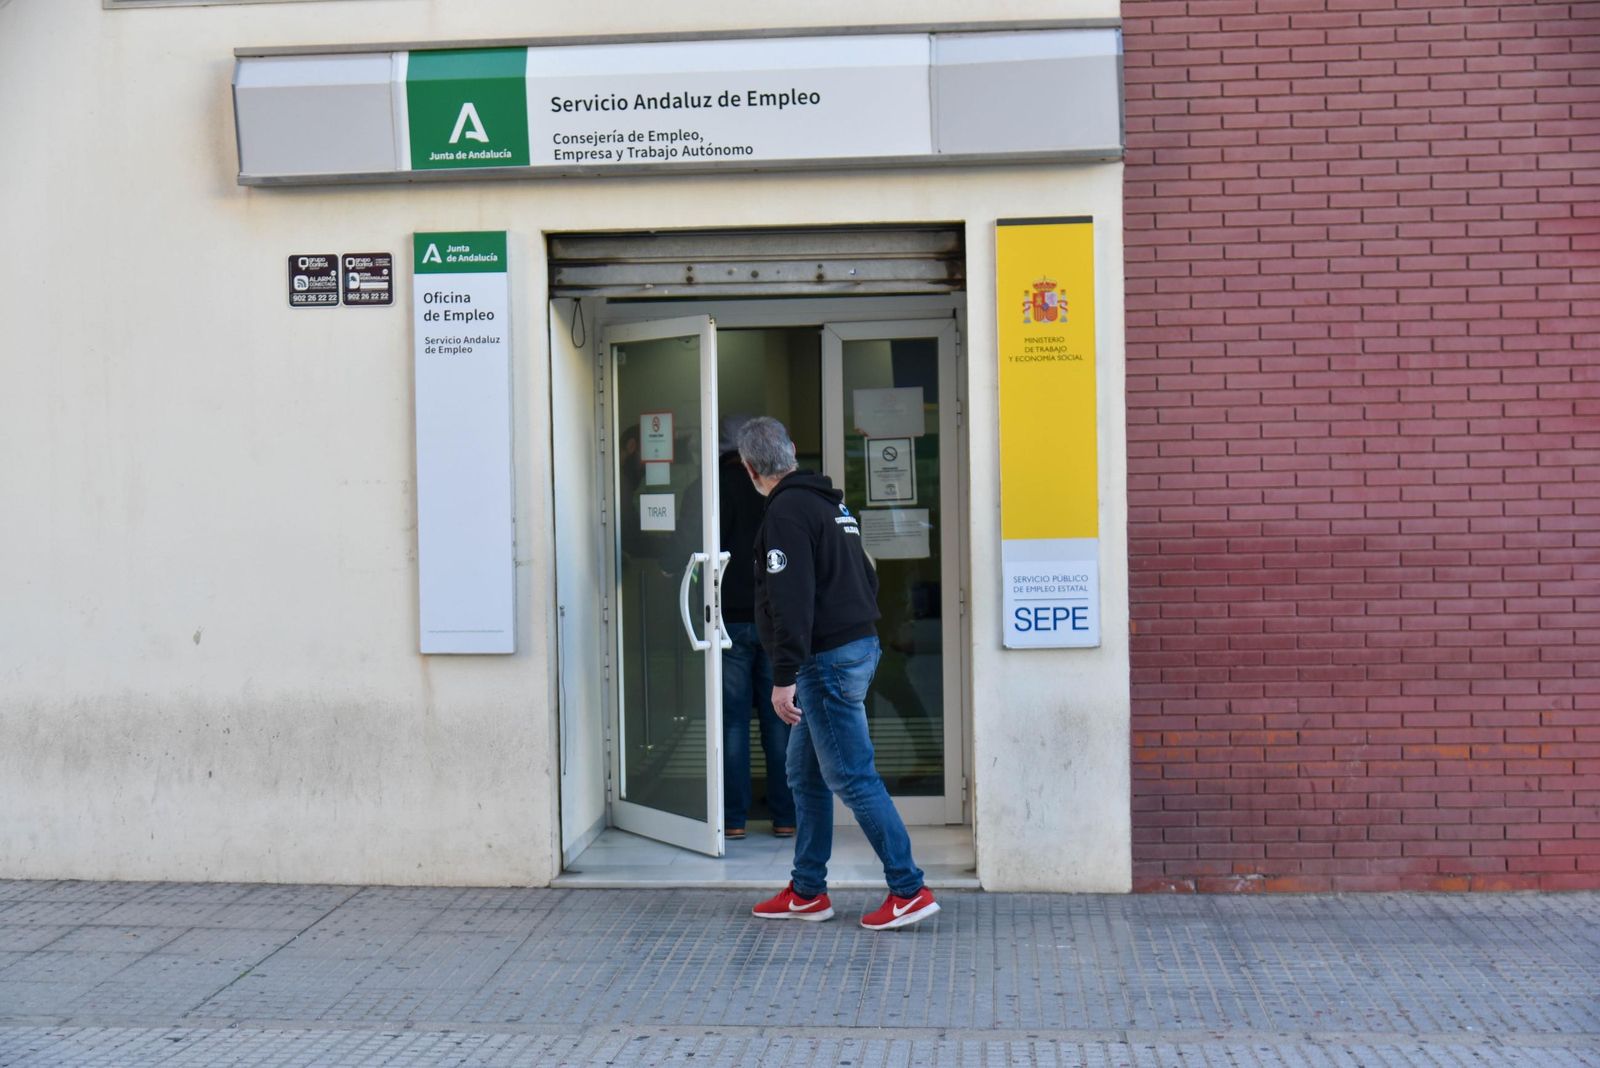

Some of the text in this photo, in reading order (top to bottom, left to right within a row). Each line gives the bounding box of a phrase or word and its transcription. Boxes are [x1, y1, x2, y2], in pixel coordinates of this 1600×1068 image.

[551, 88, 820, 112] Servicio Andaluz de Empleo
[553, 129, 704, 146] Consejería de Empleo,
[429, 149, 512, 160] Junta de Andalucía
[554, 142, 753, 162] Empresa y Trabajo Autónomo
[446, 245, 470, 253] Junta
[446, 253, 498, 262] de Andalucía
[423, 291, 471, 304] Oficina
[423, 309, 495, 324] de Empleo
[425, 335, 501, 345] Servicio Andaluz
[1024, 336, 1065, 344] MINISTERIO
[425, 345, 473, 355] de Empleo
[1035, 345, 1067, 353] TRABAJO
[1015, 354, 1056, 362] ECONOMÍA
[648, 506, 667, 517] TIRAR
[1013, 573, 1089, 584] SERVICIO PÚBLICO
[1026, 585, 1056, 593] EMPLEO
[1058, 584, 1088, 592] ESTATAL
[1014, 606, 1089, 632] SEPE
